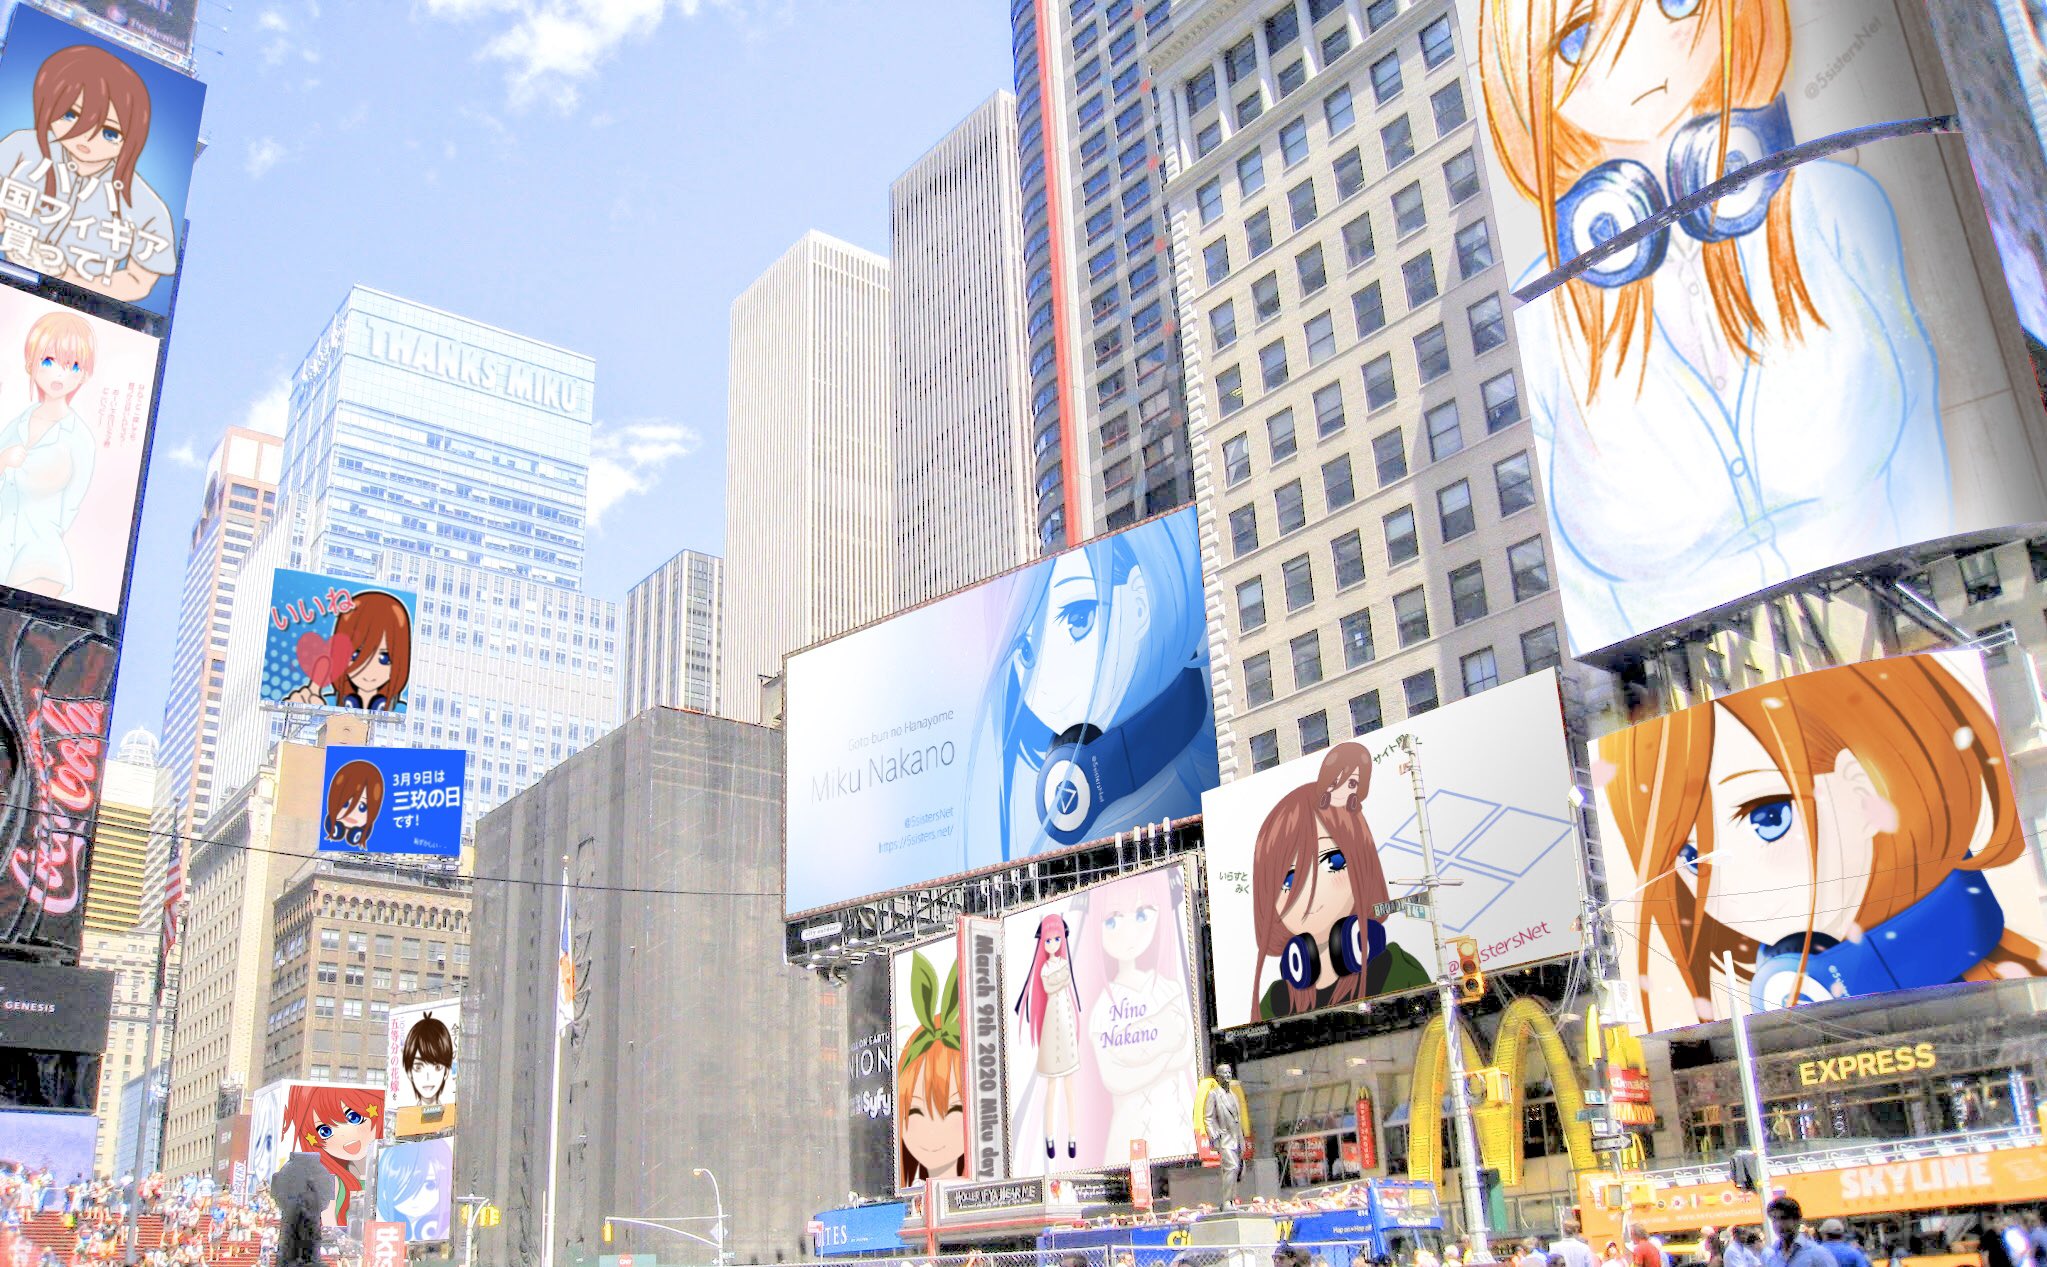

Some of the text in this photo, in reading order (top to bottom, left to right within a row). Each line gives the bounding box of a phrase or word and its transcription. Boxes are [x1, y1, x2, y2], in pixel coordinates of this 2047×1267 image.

[1804, 16, 1883, 99] @5sistersNet
[28, 156, 125, 212] パパ
[0, 175, 170, 261] 国フィギア
[365, 317, 498, 389] THANKS
[504, 362, 578, 413] MIKU
[271, 587, 355, 631] いいね
[904, 710, 954, 734] Hanayome
[392, 769, 446, 787] 3月9日は
[810, 740, 955, 804] Miku Nakano
[392, 786, 461, 812] 三玖の日
[904, 806, 954, 829] @5sistersNet
[1219, 871, 1248, 881] いらすと
[1235, 883, 1250, 894] みく
[1448, 921, 1552, 976] @stersNet
[4, 1001, 56, 1013] GENESIS
[1109, 997, 1147, 1021] Nino
[869, 1032, 890, 1046] EARTH
[1100, 1023, 1158, 1048] Nakano
[975, 934, 1000, 1178] March 9th 2020 Miku day
[1799, 1042, 1937, 1086] EXPRESS
[862, 1087, 891, 1119] Syfy
[1840, 1154, 1993, 1200] SKYLINE
